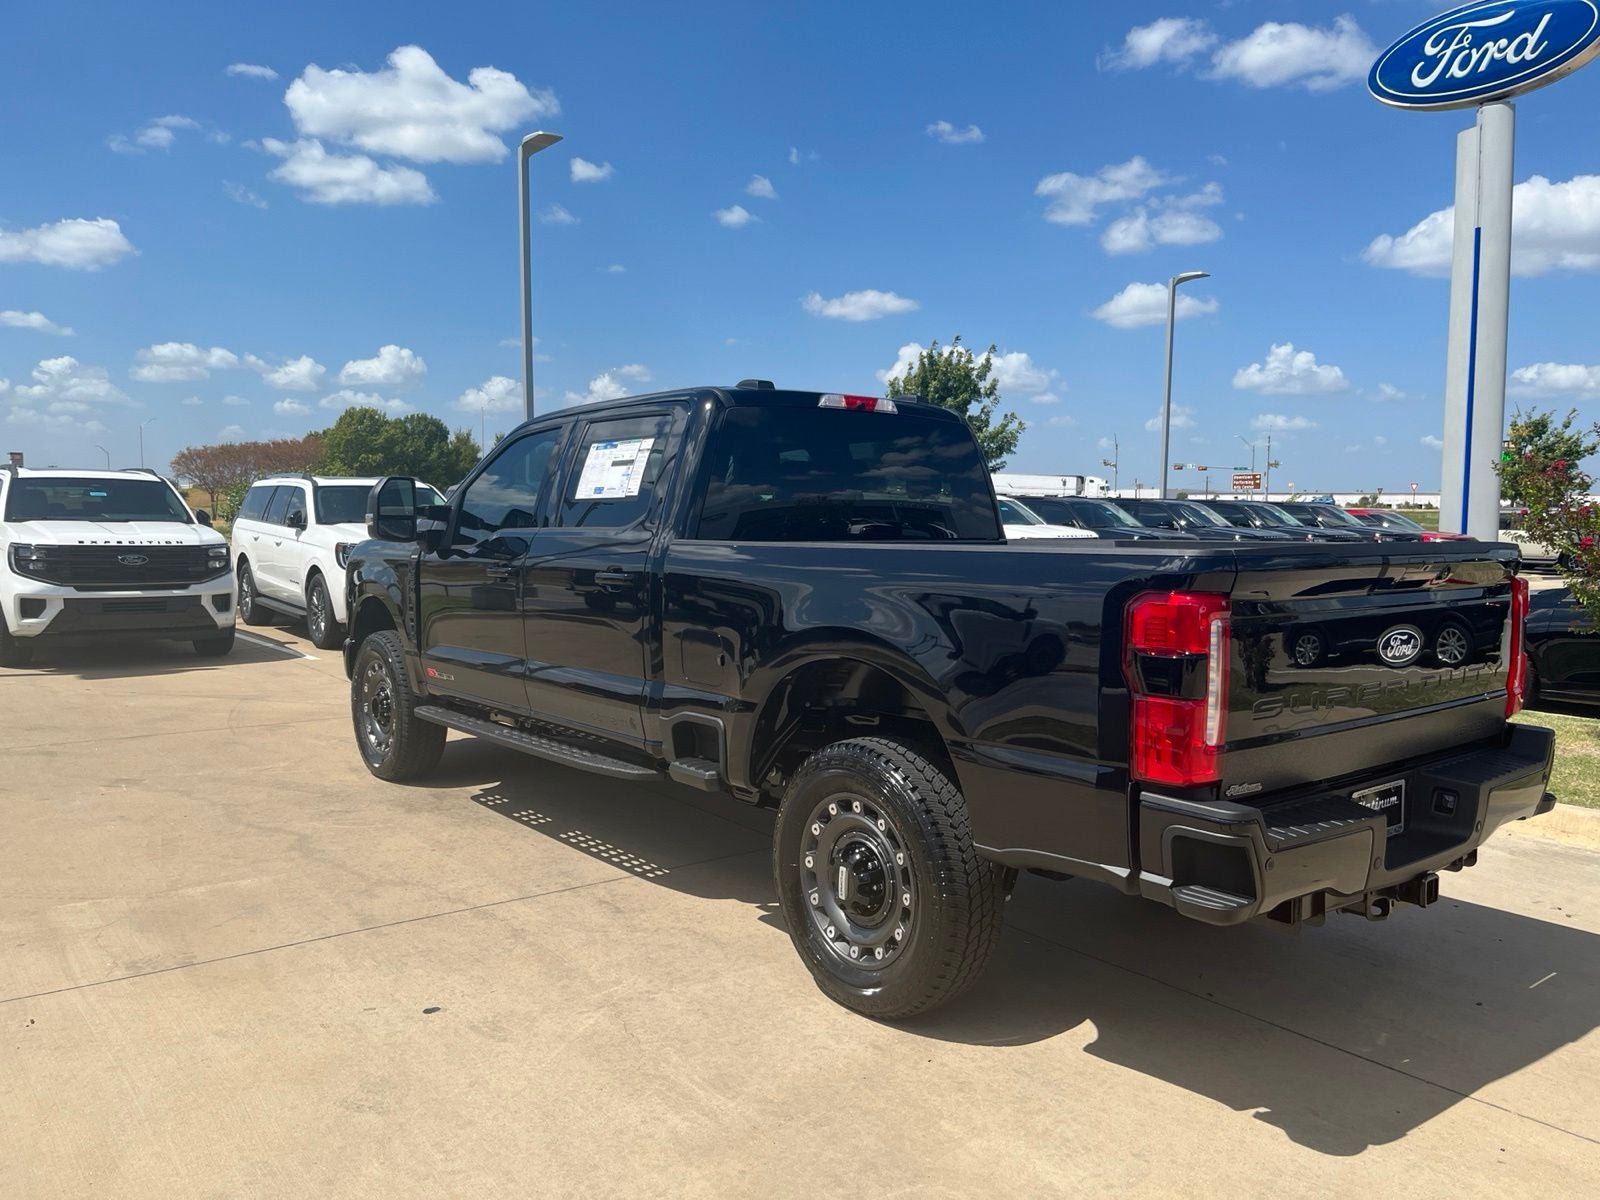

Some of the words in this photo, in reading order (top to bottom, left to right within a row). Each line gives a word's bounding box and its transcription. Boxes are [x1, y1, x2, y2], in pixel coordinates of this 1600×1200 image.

[1411, 10, 1553, 88] Ford
[1387, 634, 1415, 658] Ford
[1358, 796, 1399, 810] atinum
